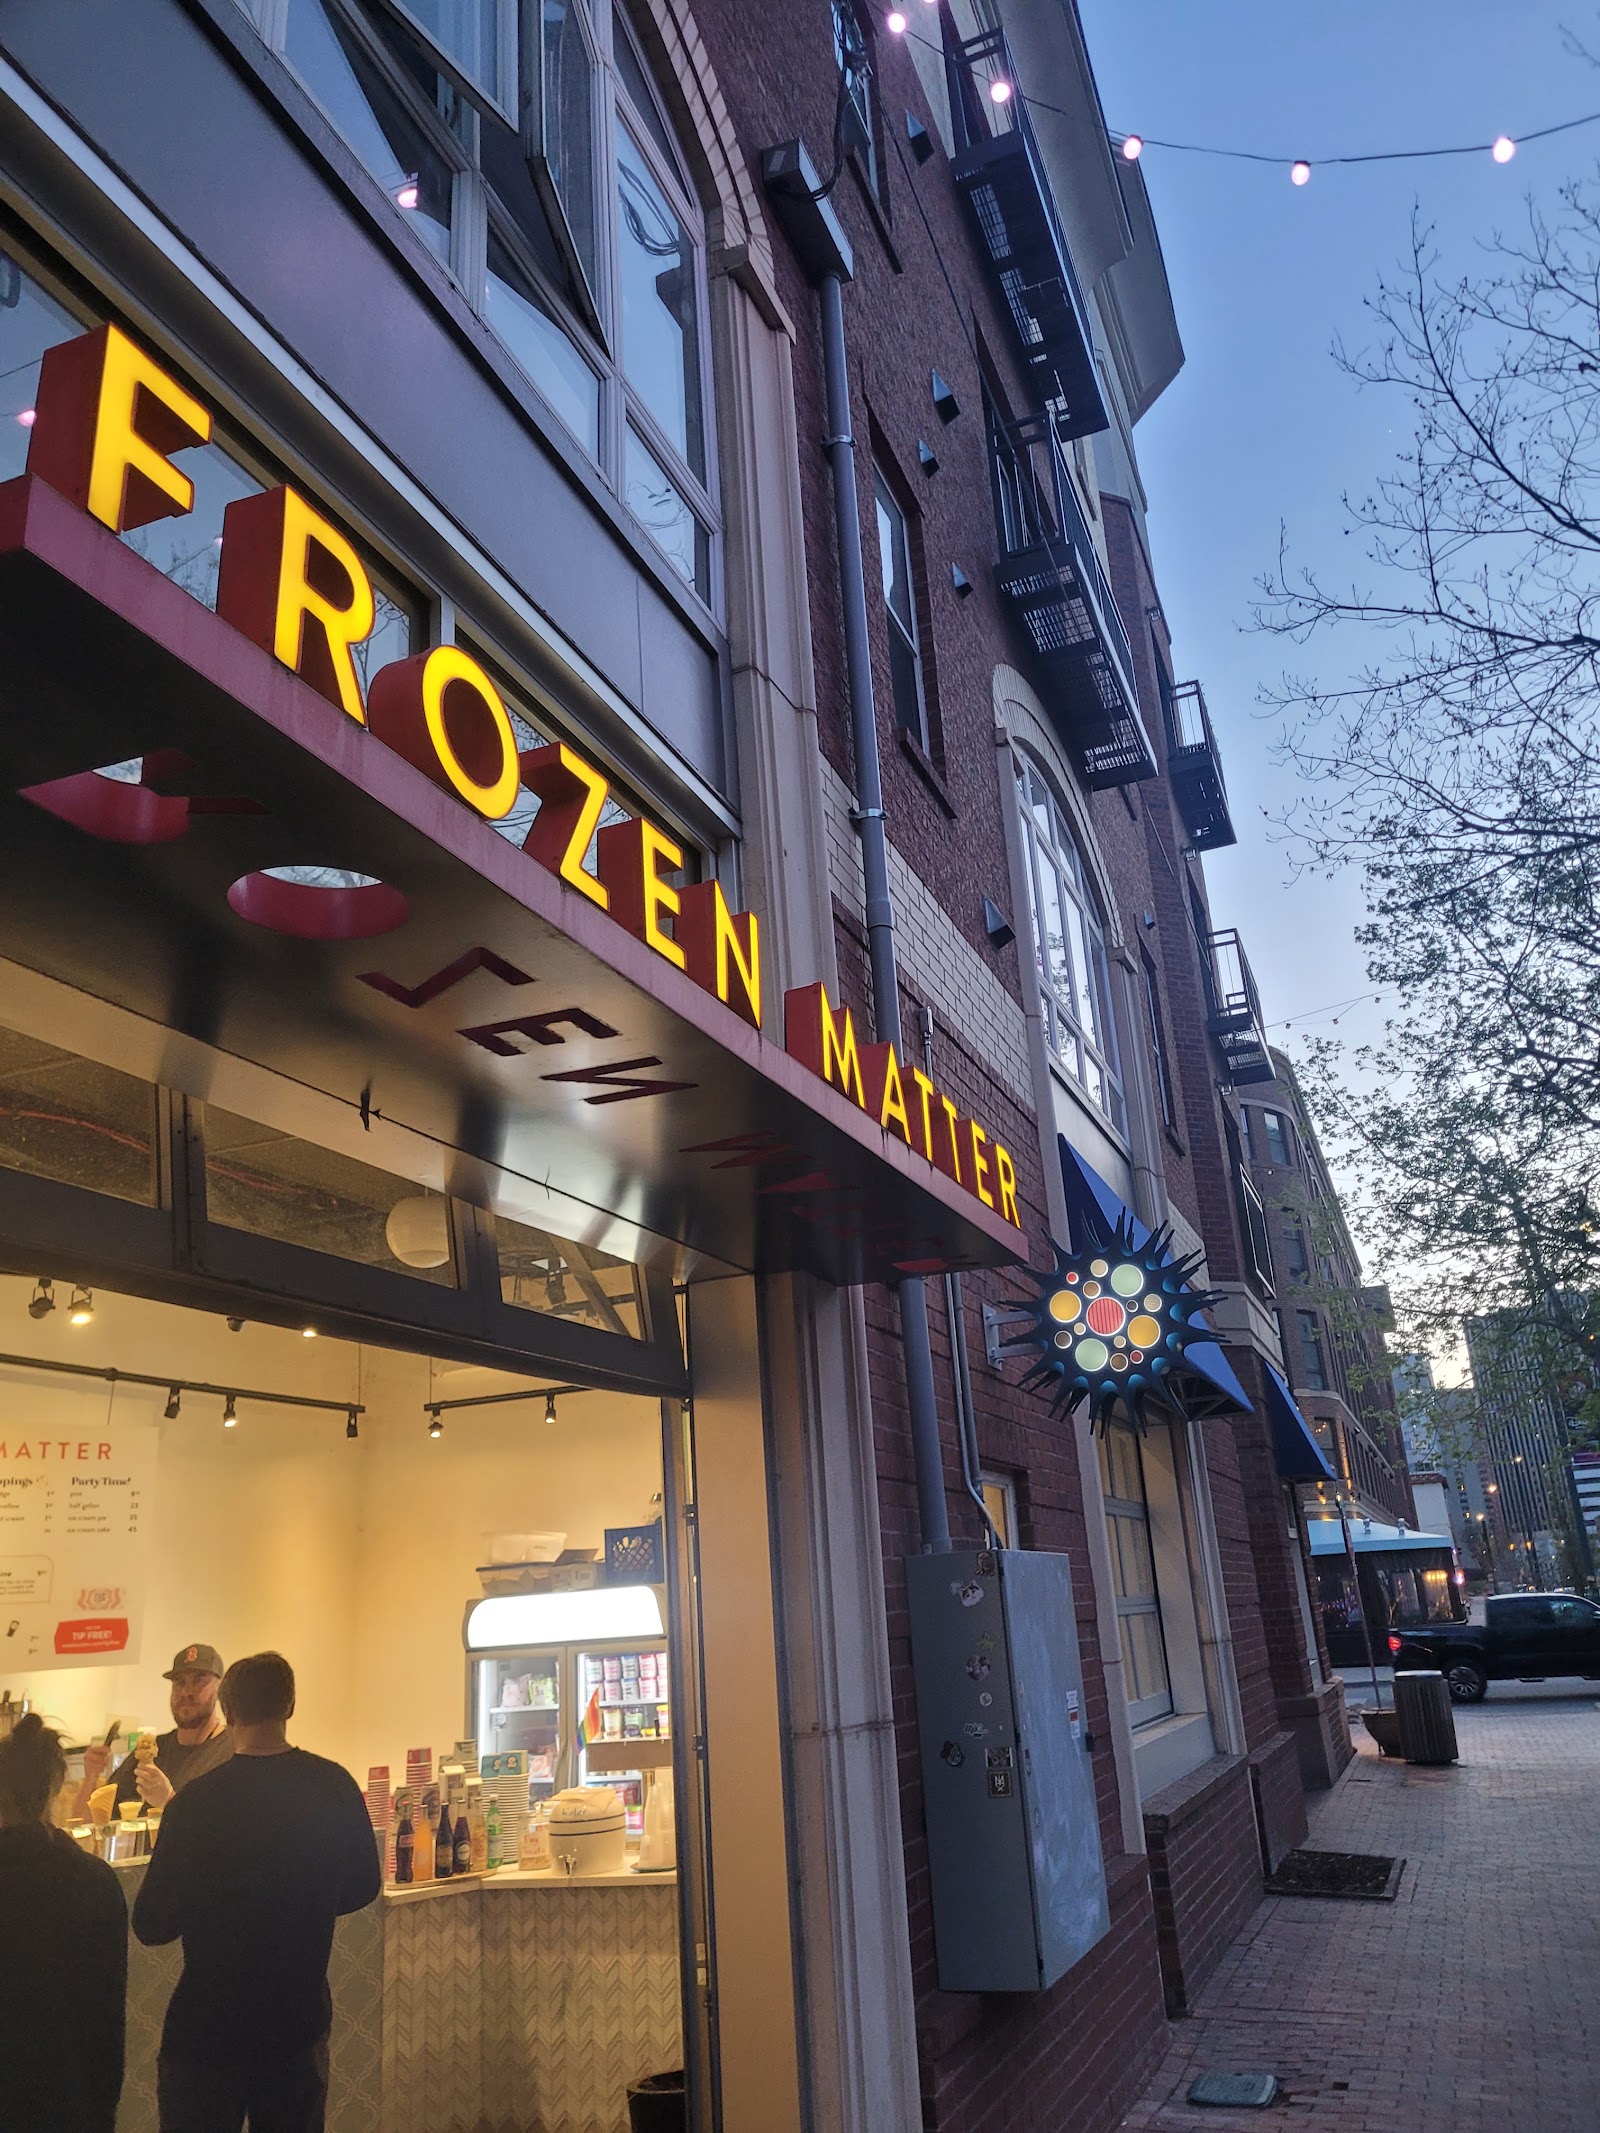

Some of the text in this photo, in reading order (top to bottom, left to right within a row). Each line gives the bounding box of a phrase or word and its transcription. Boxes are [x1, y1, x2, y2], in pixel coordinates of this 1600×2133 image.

[86, 322, 1022, 1230] FROZEN MATTER
[71, 1476, 132, 1489] Party Time!
[72, 1630, 113, 1641] TIP FREE!
